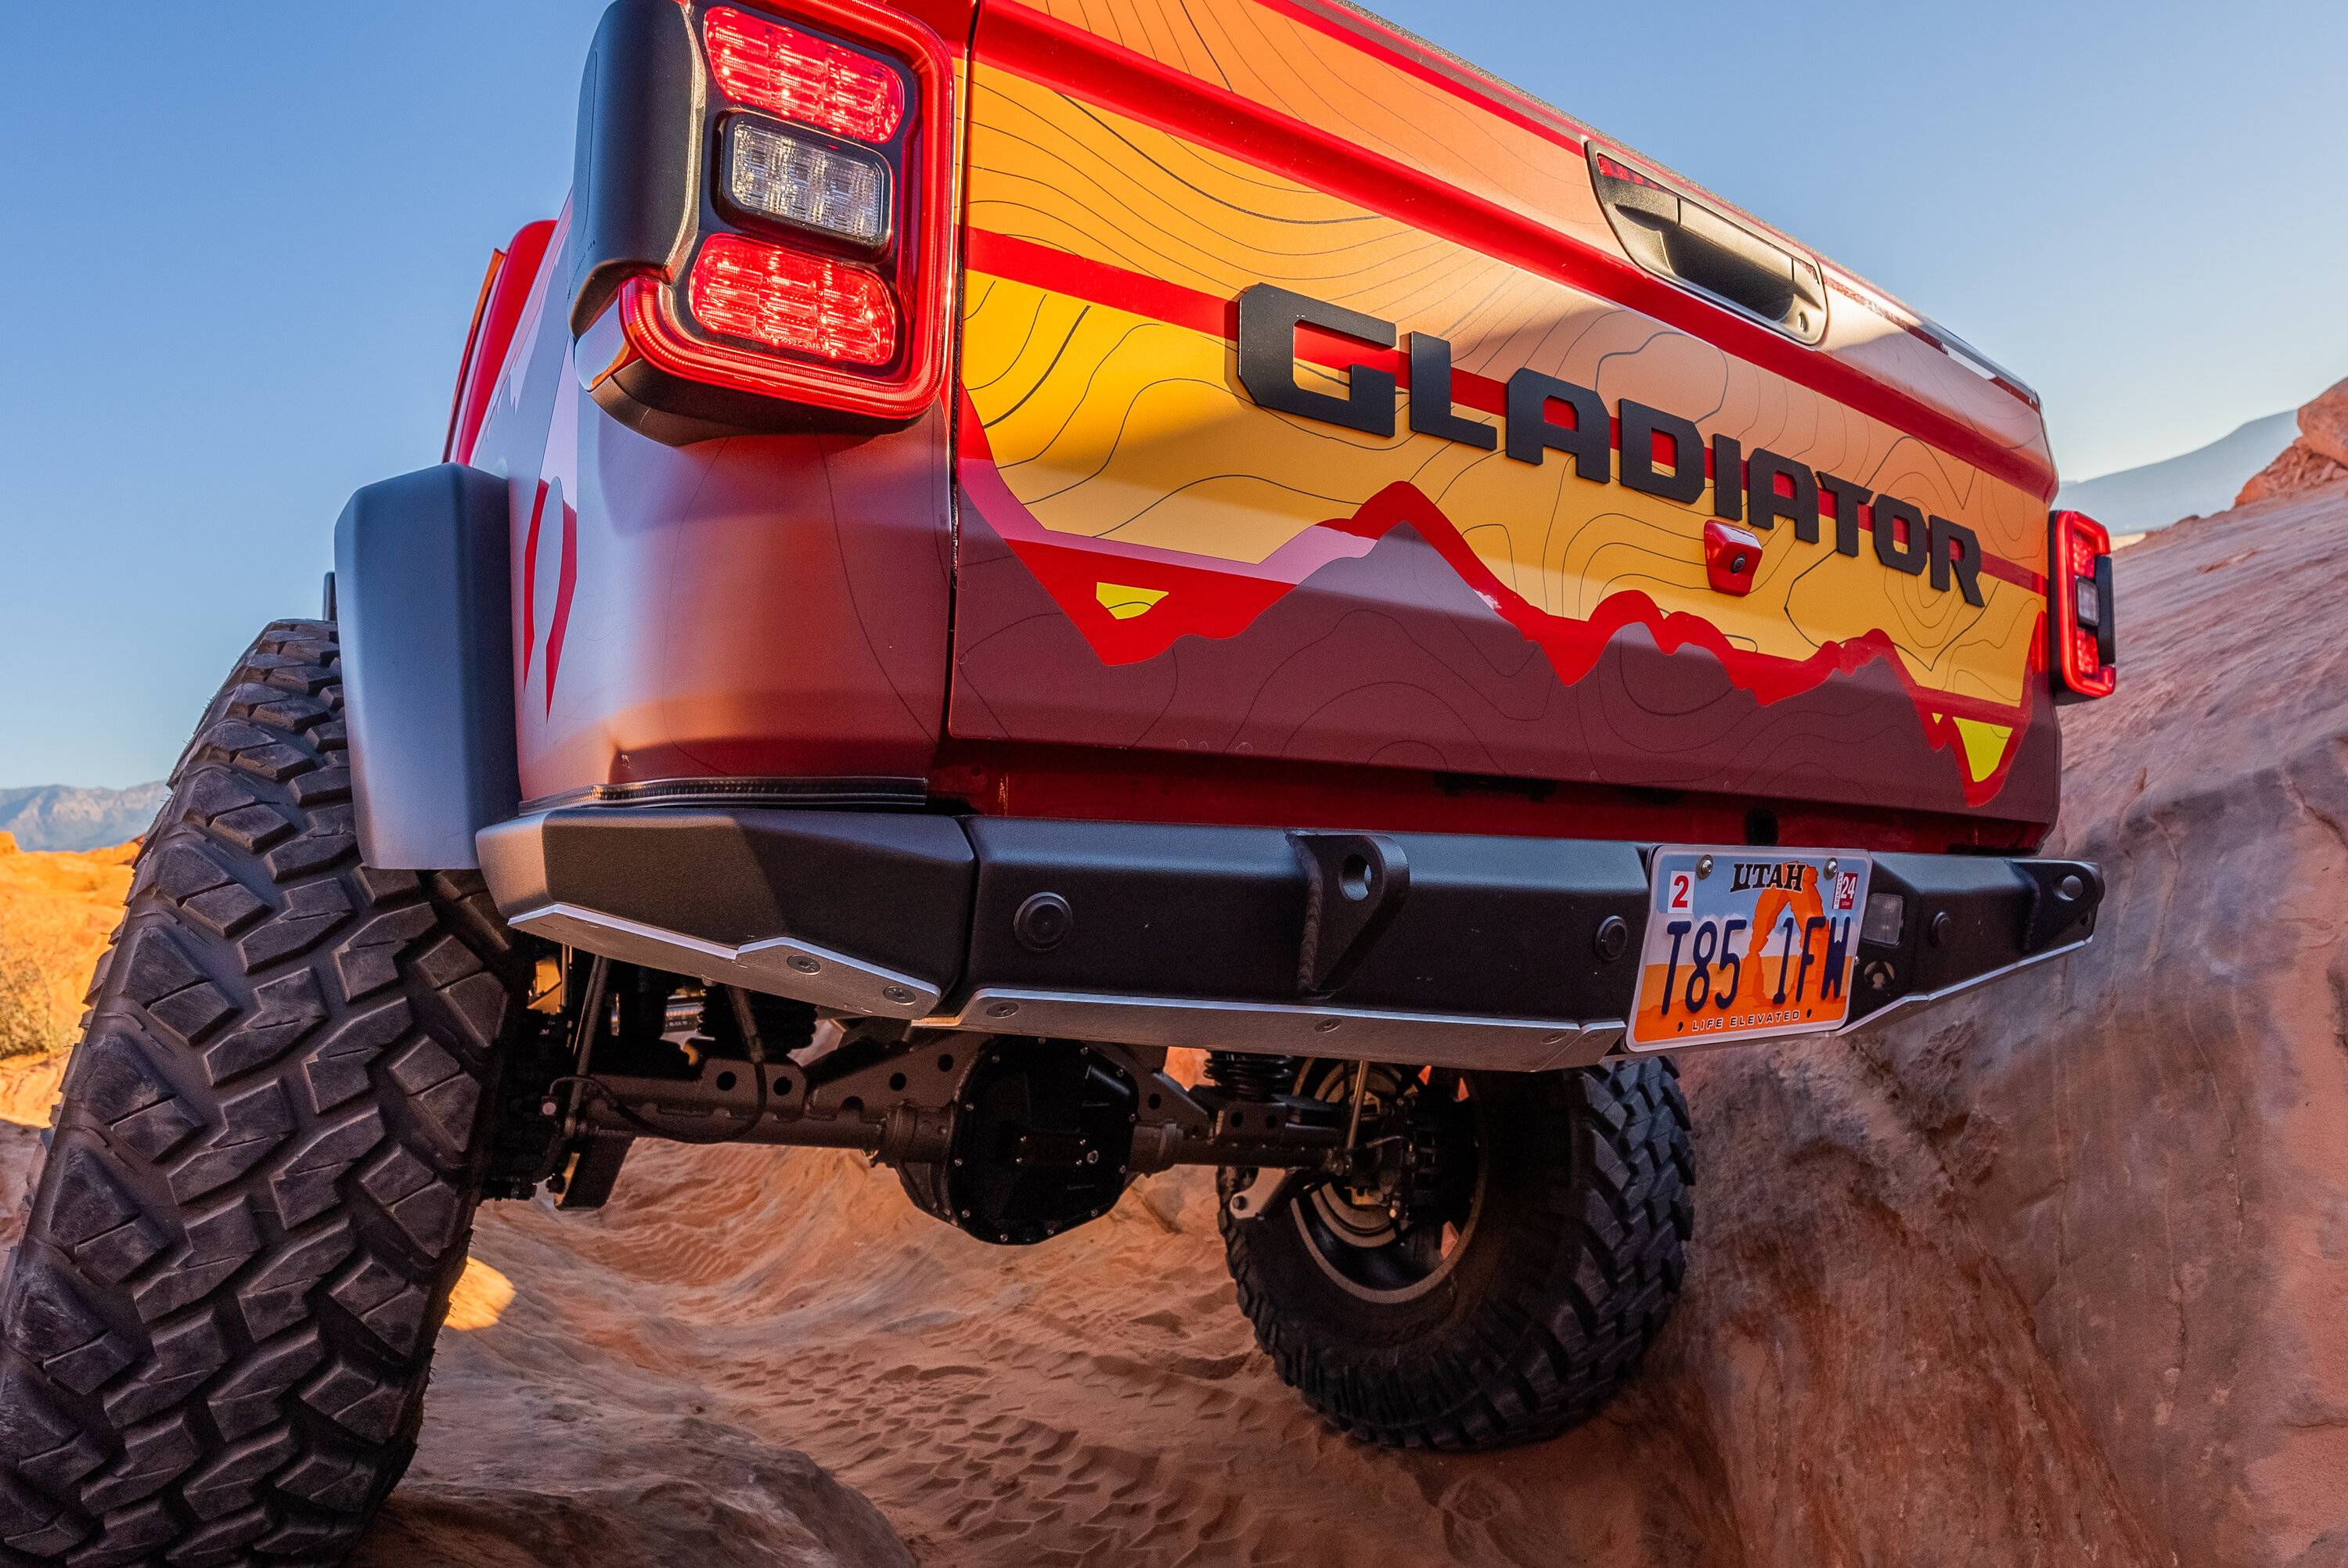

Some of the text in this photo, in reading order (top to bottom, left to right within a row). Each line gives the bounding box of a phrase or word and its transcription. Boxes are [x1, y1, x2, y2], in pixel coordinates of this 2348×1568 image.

[1239, 282, 1985, 608] GLADIATOR
[1672, 875, 1690, 908] 2
[1730, 863, 1806, 894] UTAH
[1842, 876, 1857, 900] 24
[1661, 919, 1748, 1016] T85
[1692, 1010, 1800, 1032] LIFE ELEVATED
